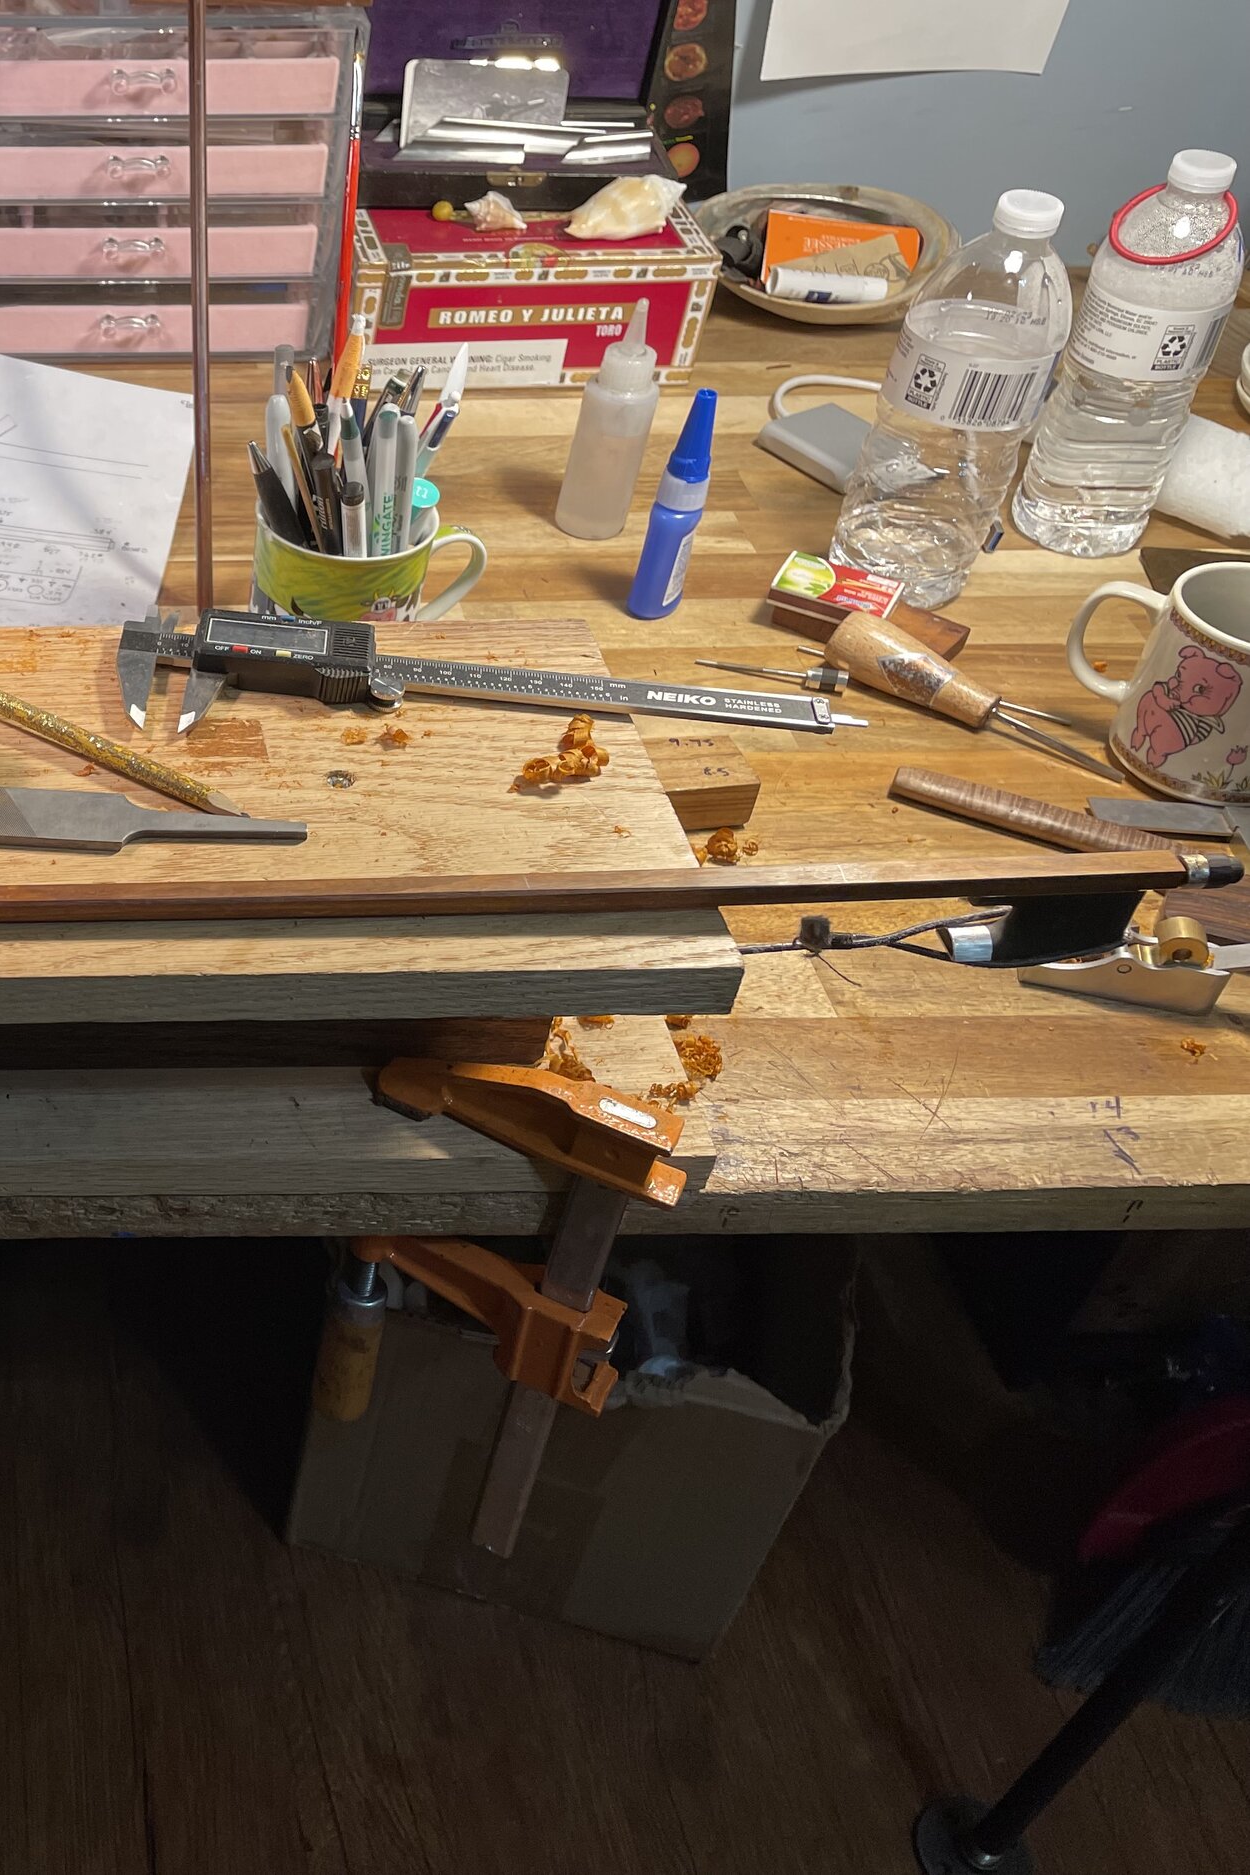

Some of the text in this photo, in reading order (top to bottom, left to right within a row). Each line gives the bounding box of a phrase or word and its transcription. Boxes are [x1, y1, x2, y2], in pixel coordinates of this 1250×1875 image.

[439, 306, 624, 325] ROMEO Y JULIETA
[596, 325, 622, 337] TORO
[367, 352, 552, 366] SURGEON GENERAL WNING: Cigar Smoking
[479, 364, 501, 373] Heart
[647, 690, 717, 706] NEIKO
[724, 697, 781, 708] STAINLESS
[725, 703, 782, 713] HARDENED
[668, 738, 715, 747] 9.75
